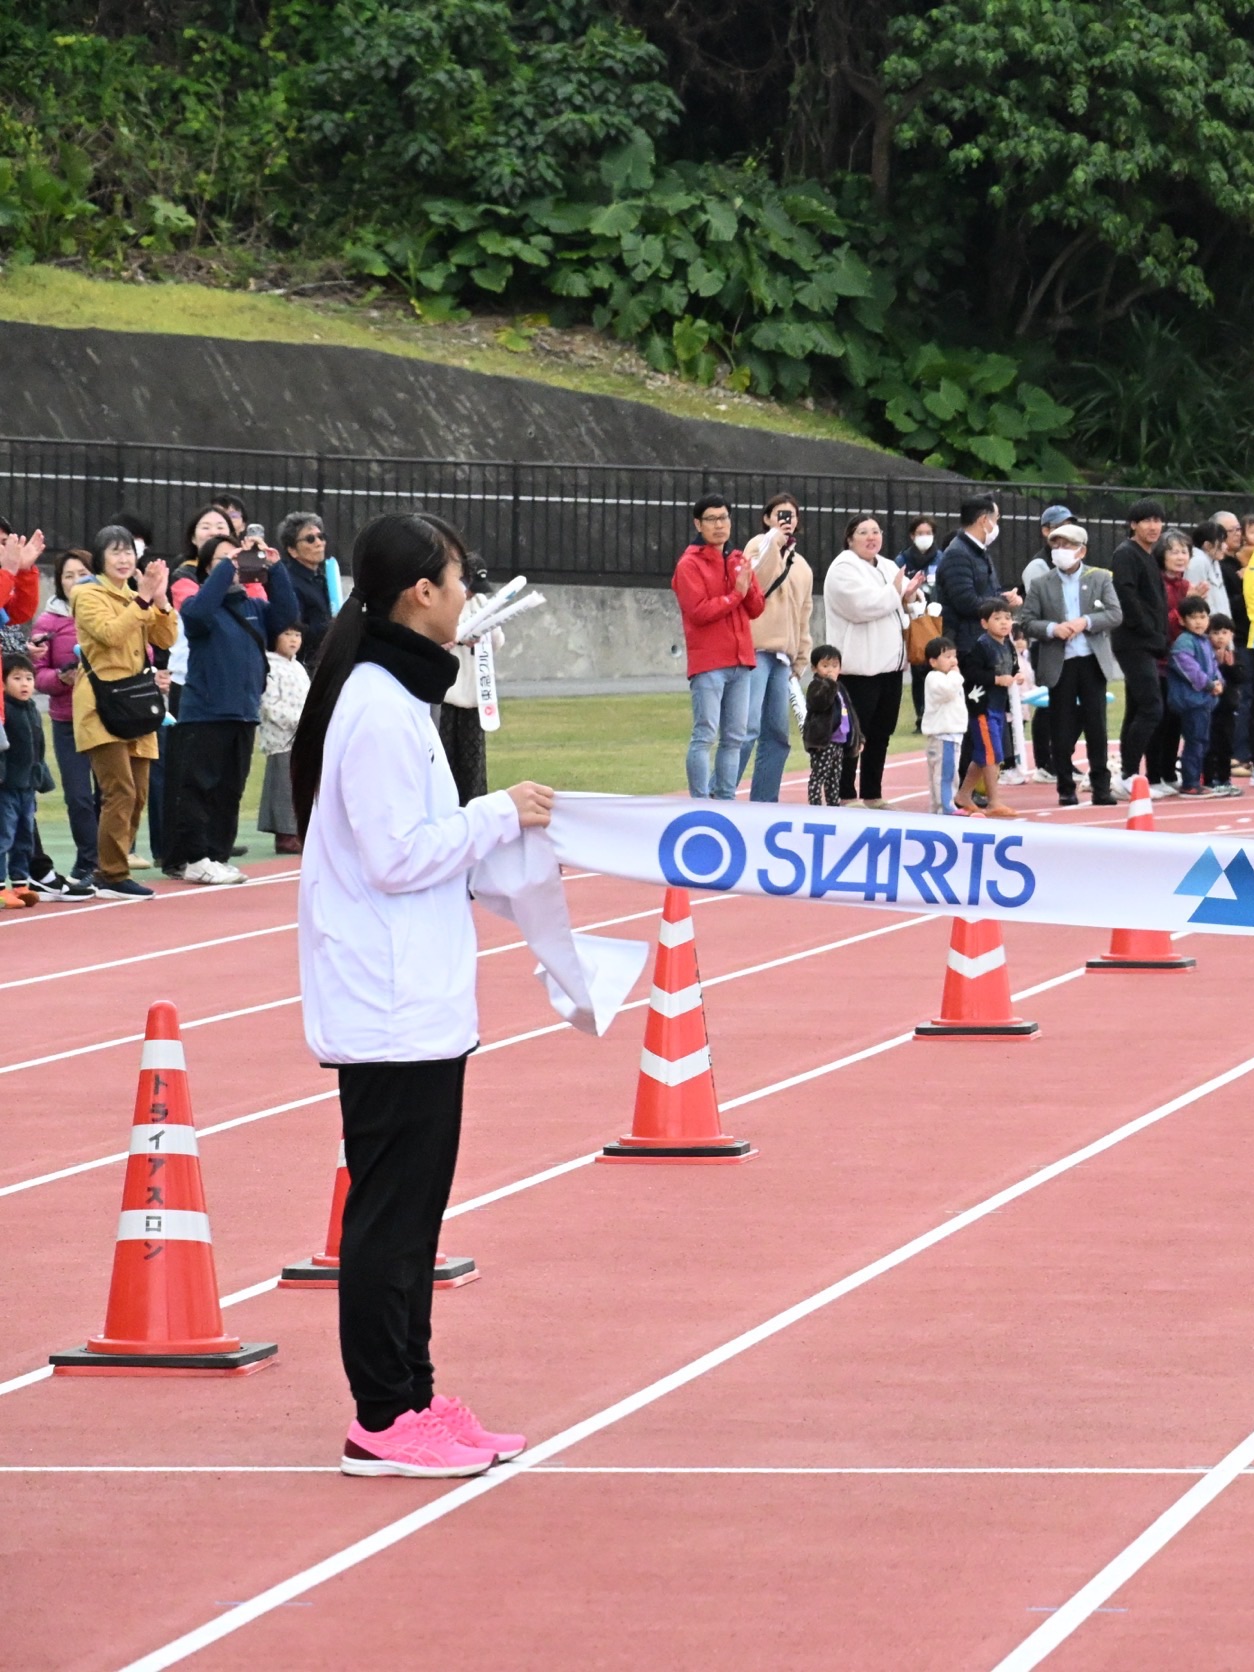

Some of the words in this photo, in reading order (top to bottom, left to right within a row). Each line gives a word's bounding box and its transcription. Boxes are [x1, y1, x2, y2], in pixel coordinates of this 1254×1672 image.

[757, 820, 1036, 909] STARTS
[143, 1073, 169, 1261] トライアスロン
